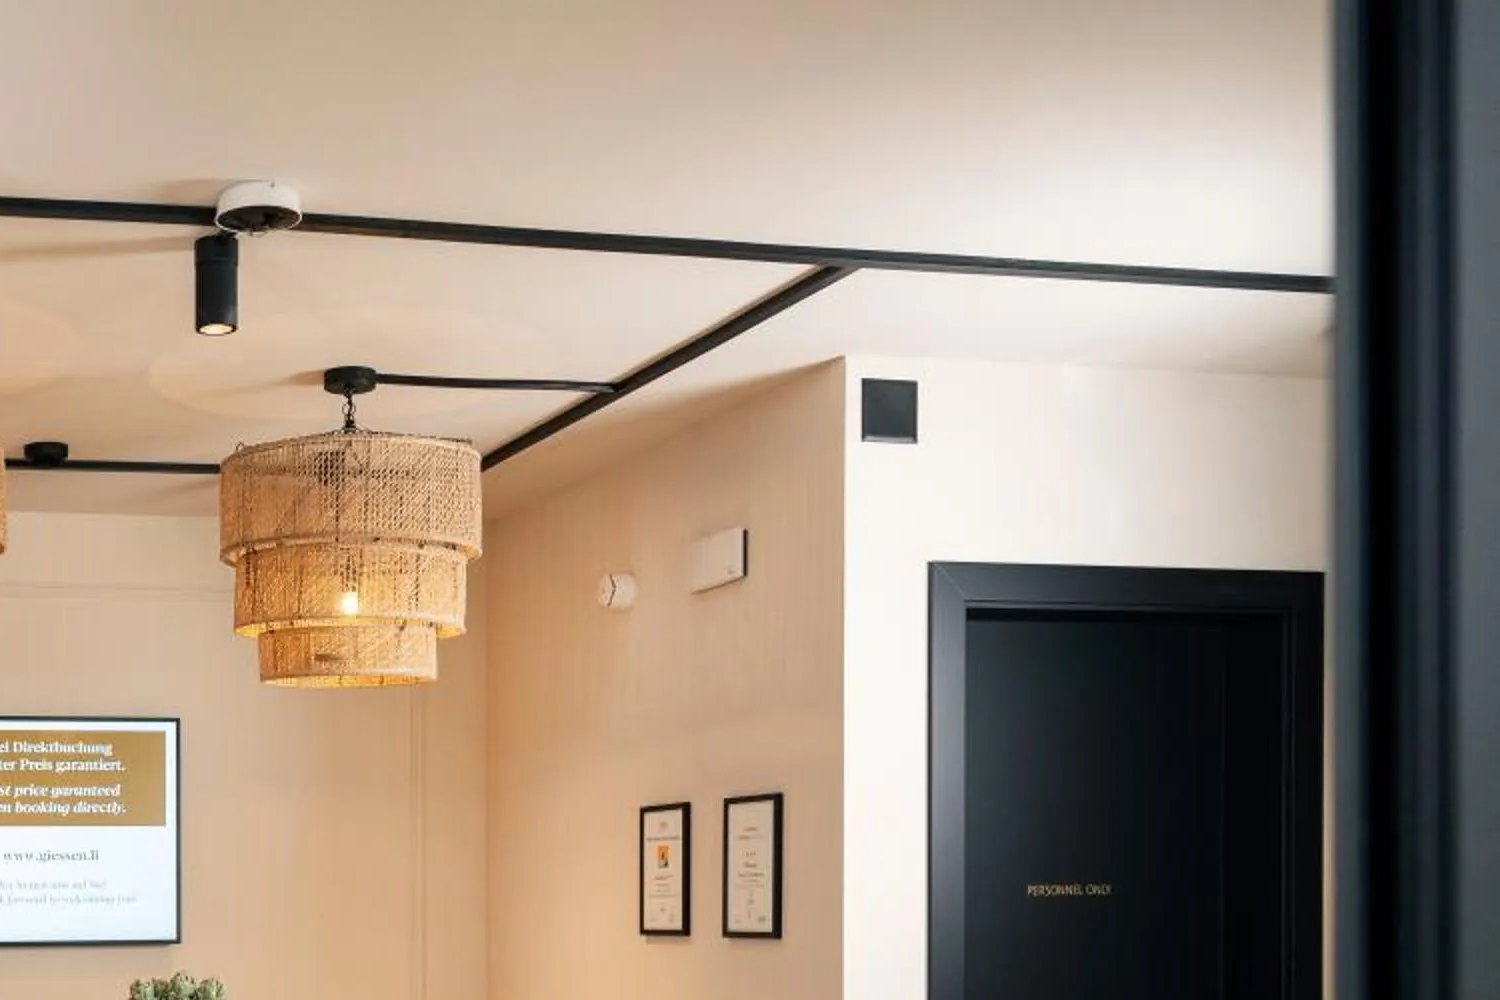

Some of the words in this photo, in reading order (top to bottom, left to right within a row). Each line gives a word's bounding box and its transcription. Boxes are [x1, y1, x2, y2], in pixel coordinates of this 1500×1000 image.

[13, 741, 113, 756] Direktbuchung
[19, 758, 53, 771] Preis
[55, 758, 125, 774] garantiert.
[14, 784, 48, 798] price
[15, 801, 70, 816] booking
[1027, 884, 1083, 896] PERSONNEL
[1085, 884, 1112, 895] ONLY
